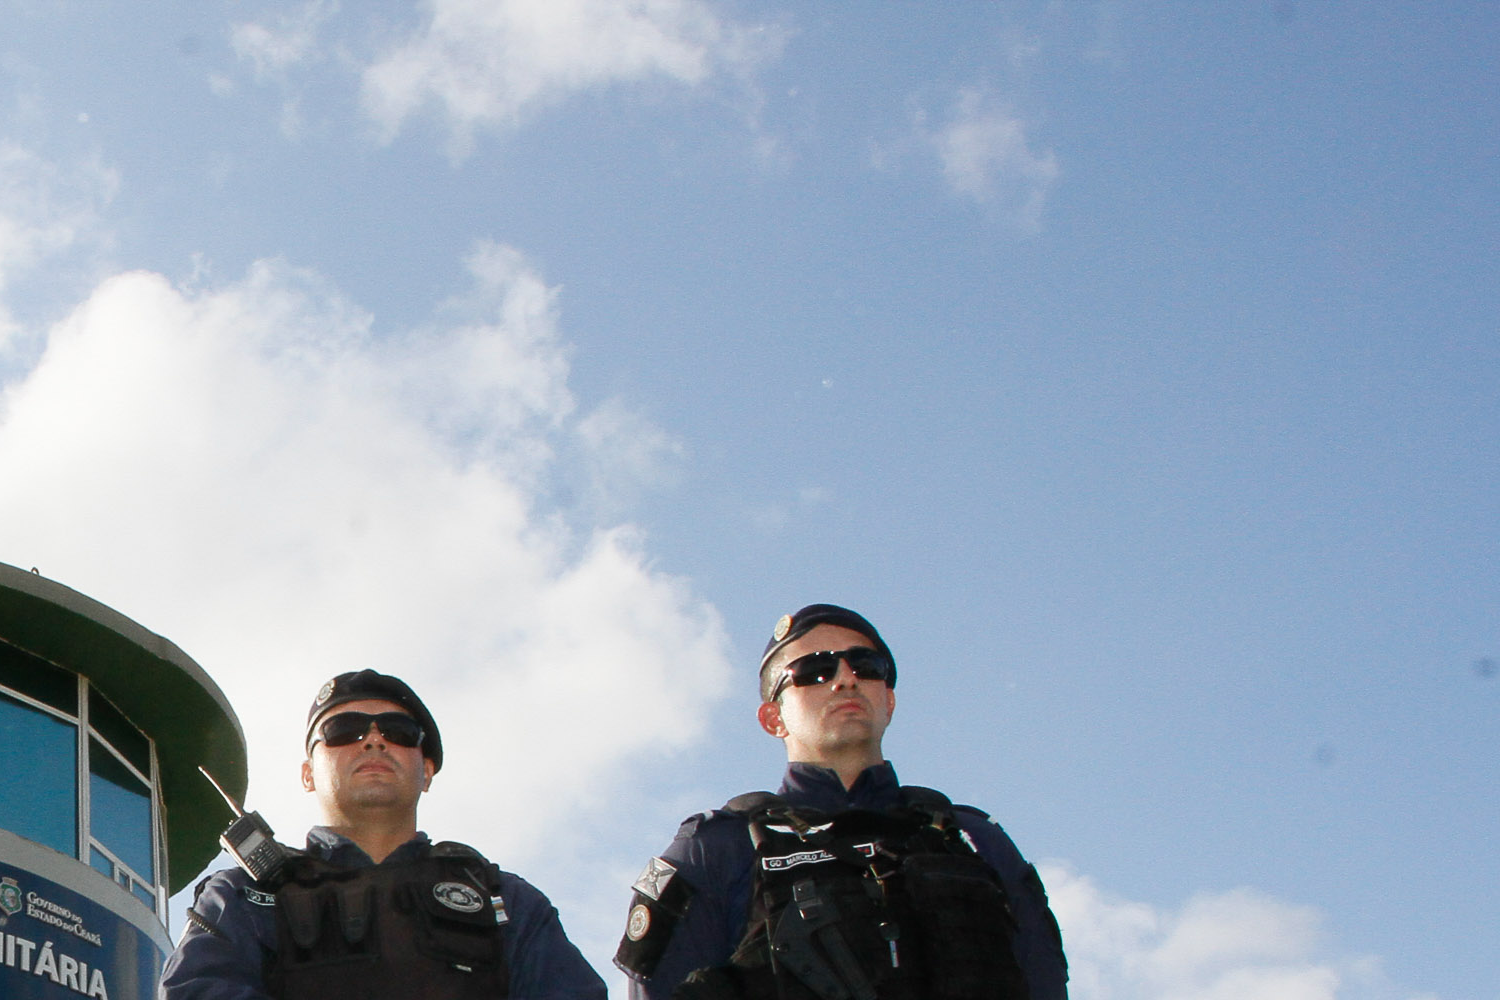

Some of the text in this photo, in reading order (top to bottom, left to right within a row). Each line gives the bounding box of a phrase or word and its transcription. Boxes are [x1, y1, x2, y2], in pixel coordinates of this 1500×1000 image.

[26, 891, 83, 924] GOVERNO DO
[26, 904, 102, 947] ESTADO DO CEARÁ
